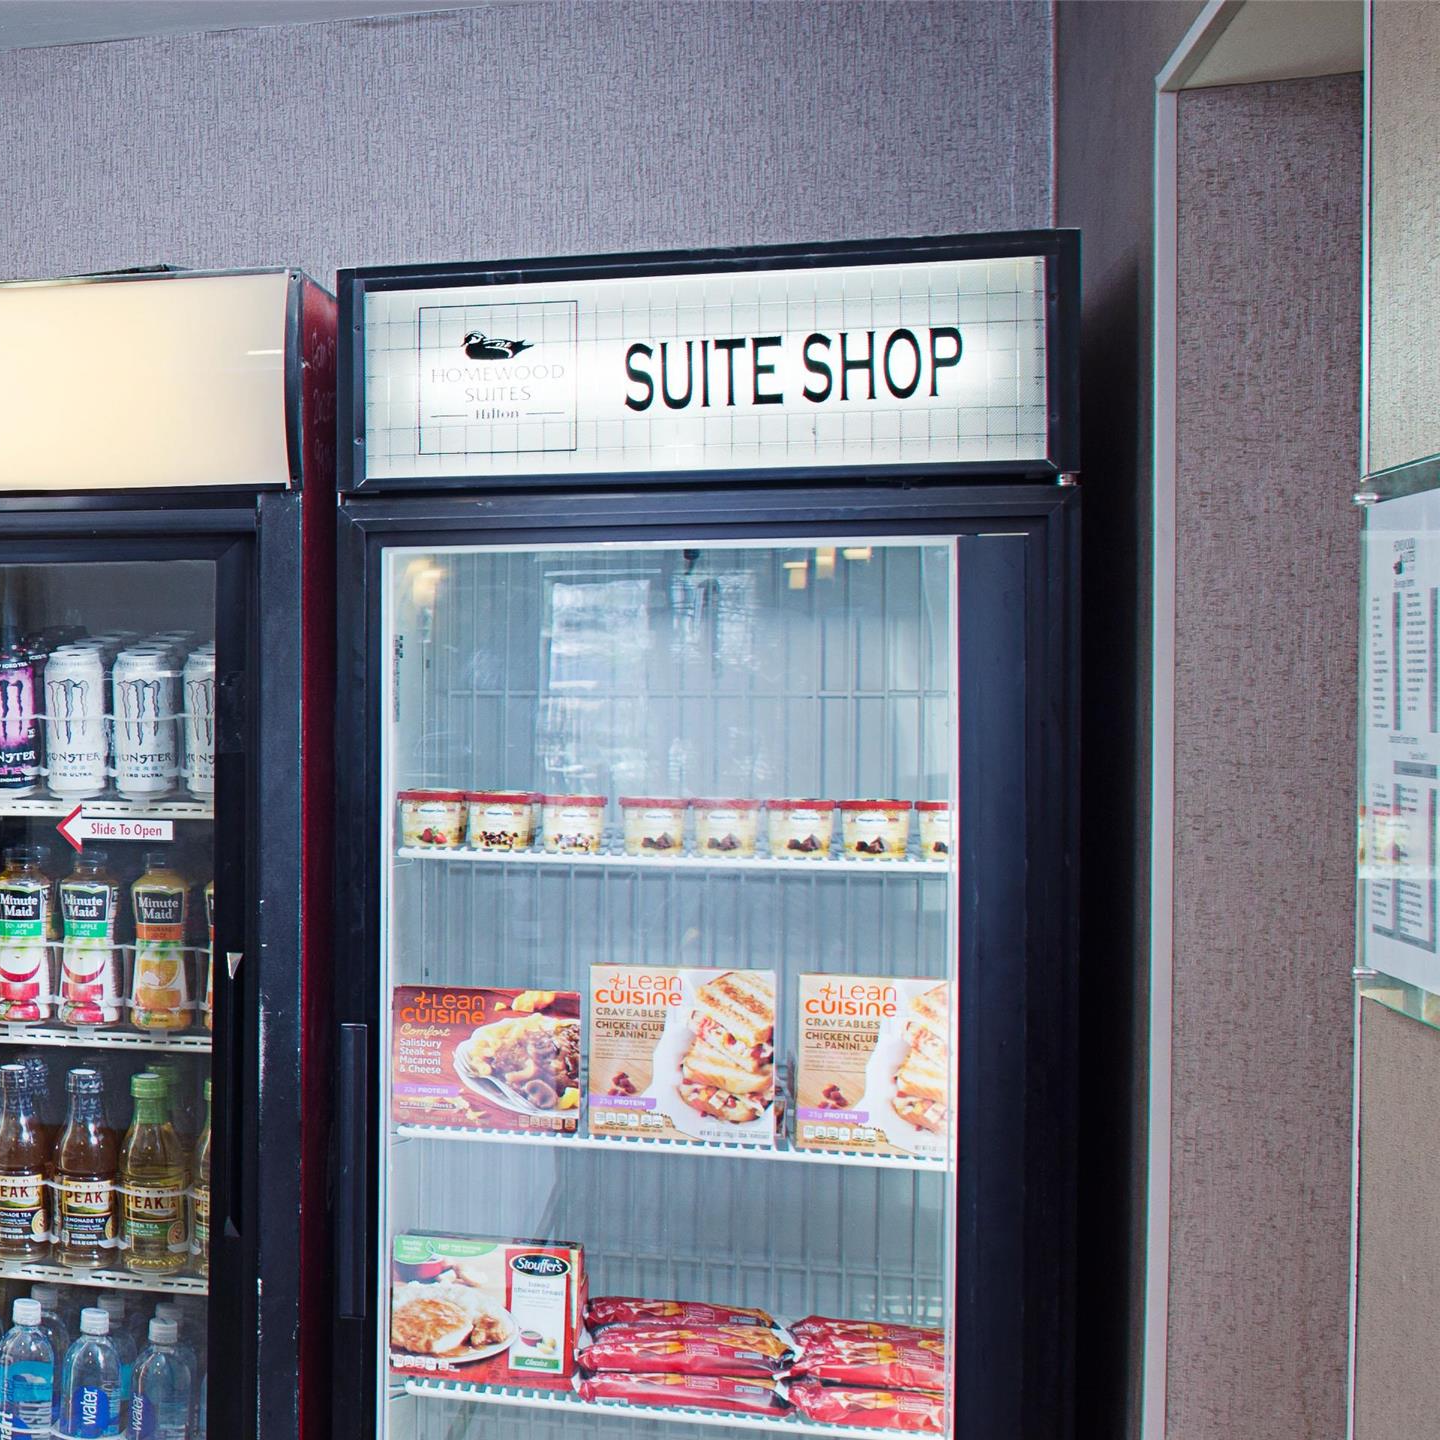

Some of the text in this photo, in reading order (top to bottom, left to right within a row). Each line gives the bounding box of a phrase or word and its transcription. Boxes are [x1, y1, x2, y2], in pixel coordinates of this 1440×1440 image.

[432, 364, 565, 383] HOMEWOOD
[626, 327, 963, 411] SUITE SHOP
[465, 385, 531, 402] SUITES
[475, 407, 519, 419] Hilton
[91, 823, 162, 838] Slide To Open
[0, 893, 38, 906] Minute
[64, 893, 103, 906] Minute
[138, 896, 178, 908] Minute
[5, 904, 34, 917] Maid
[69, 904, 99, 917] Maid
[143, 907, 173, 920] Maid
[627, 975, 682, 990] Lean
[839, 985, 897, 1000] Lean
[432, 994, 485, 1009] Lean
[596, 1008, 667, 1018] CRAVEABLES
[596, 1021, 665, 1032] CHICKEN CLUB
[806, 1018, 880, 1028] CRAVEABLES
[400, 1024, 450, 1038] Comfort
[613, 1030, 648, 1039] PANINI
[806, 1032, 879, 1043] CHICKEN CLUB
[399, 1039, 442, 1049] Salisbury
[824, 1041, 860, 1051] PANINI
[399, 1056, 441, 1065] Macaroni
[824, 1112, 858, 1120] PROTEIN
[66, 1191, 104, 1203] PEAK
[126, 1196, 164, 1209] PEAK
[517, 1257, 562, 1273] Stouffer's
[82, 1387, 98, 1426] water
[132, 1394, 143, 1431] water
